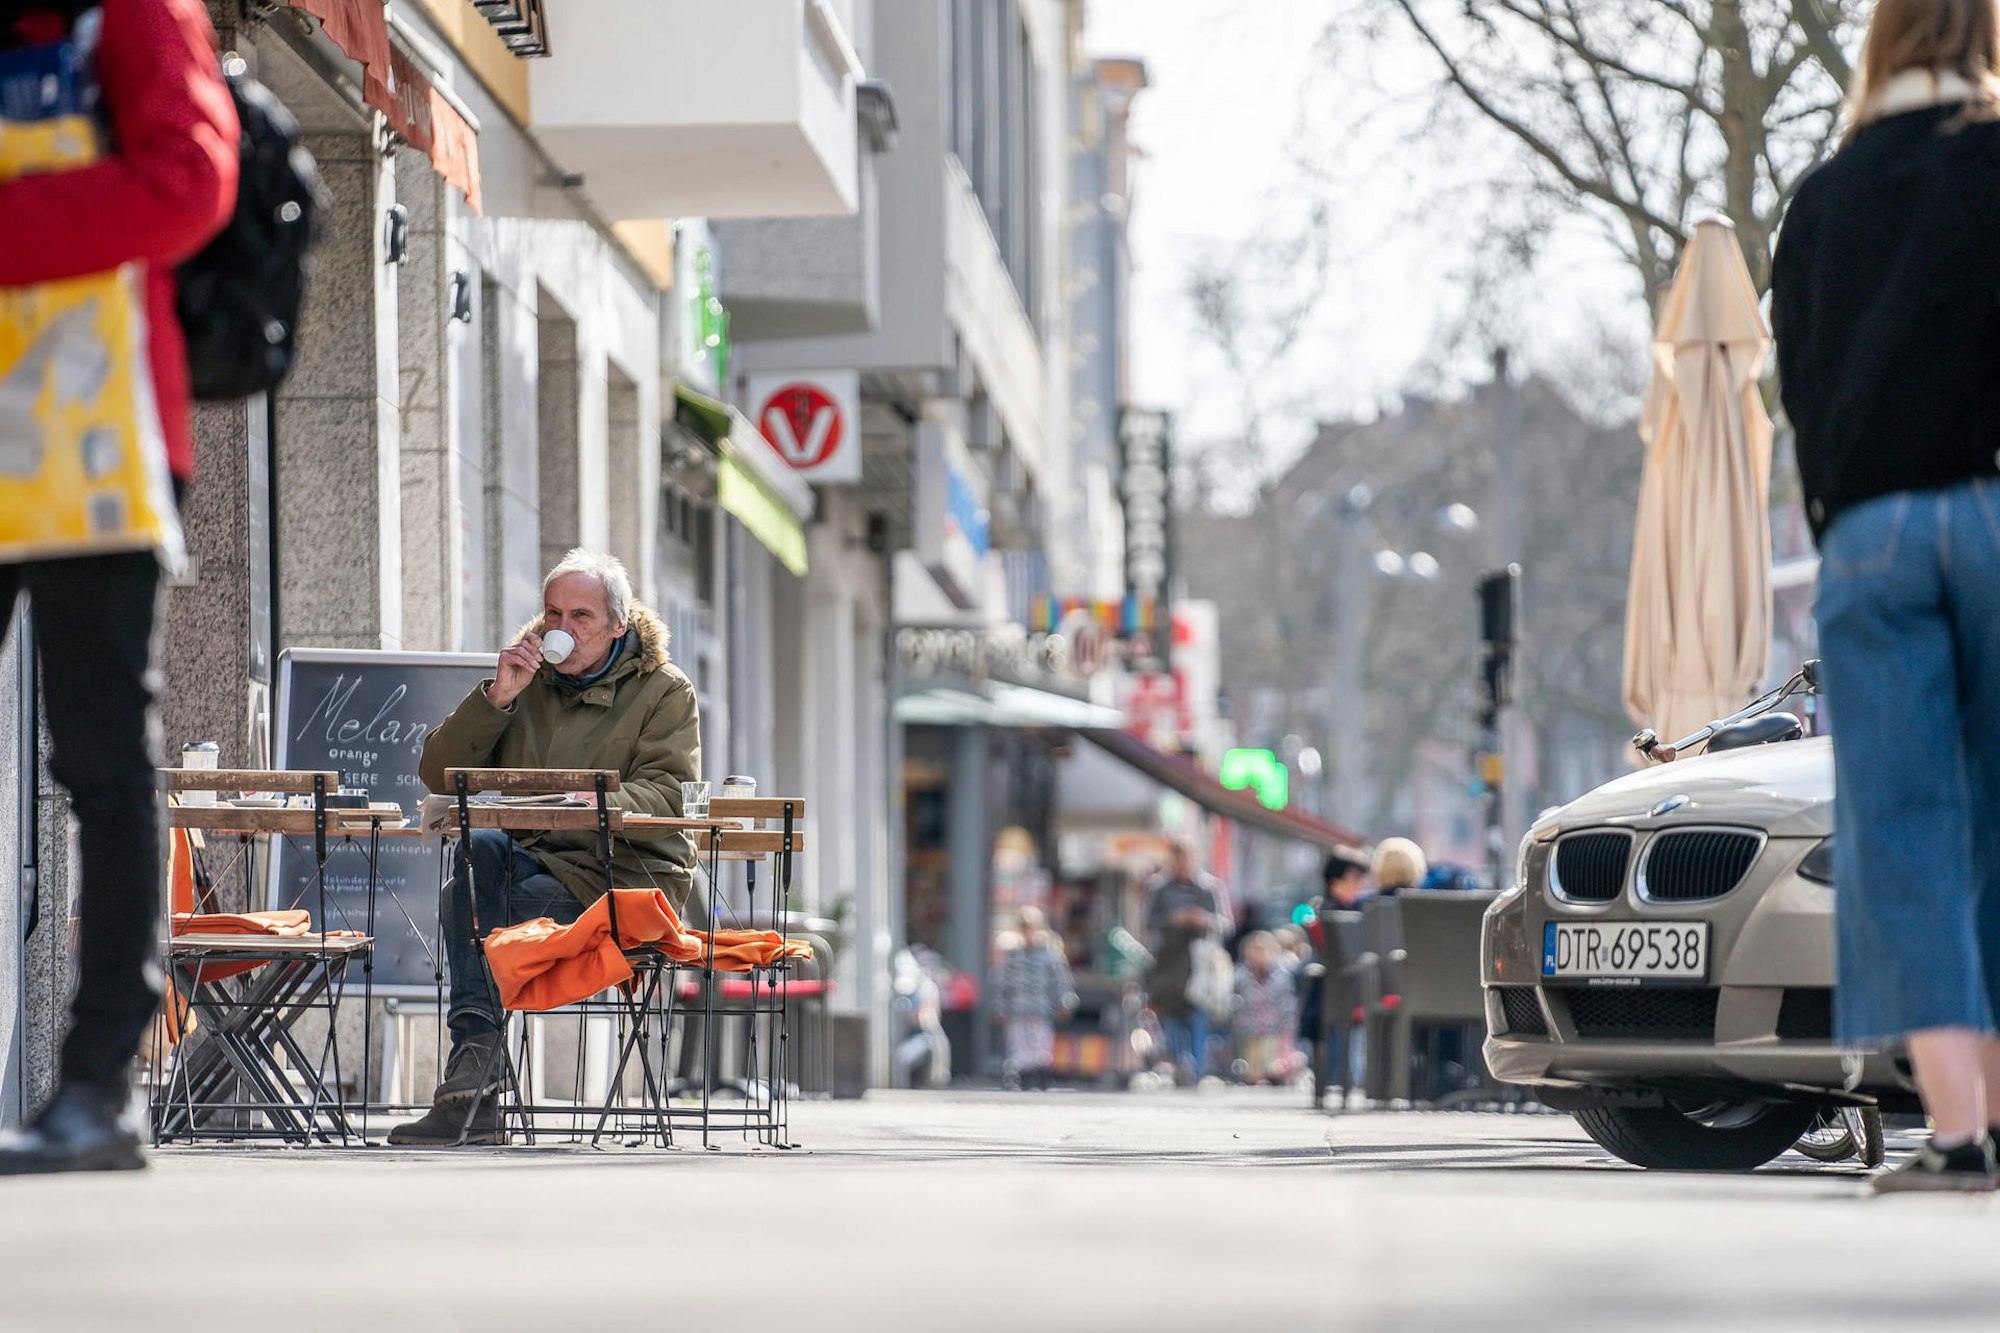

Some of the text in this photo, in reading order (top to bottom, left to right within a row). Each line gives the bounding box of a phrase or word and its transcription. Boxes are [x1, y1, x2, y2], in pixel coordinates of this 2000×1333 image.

[296, 673, 427, 752] Melan
[328, 748, 379, 767] orange
[344, 772, 421, 787] SERE SCH
[1557, 928, 1700, 970] DTR 69538
[1545, 954, 1555, 967] PL
